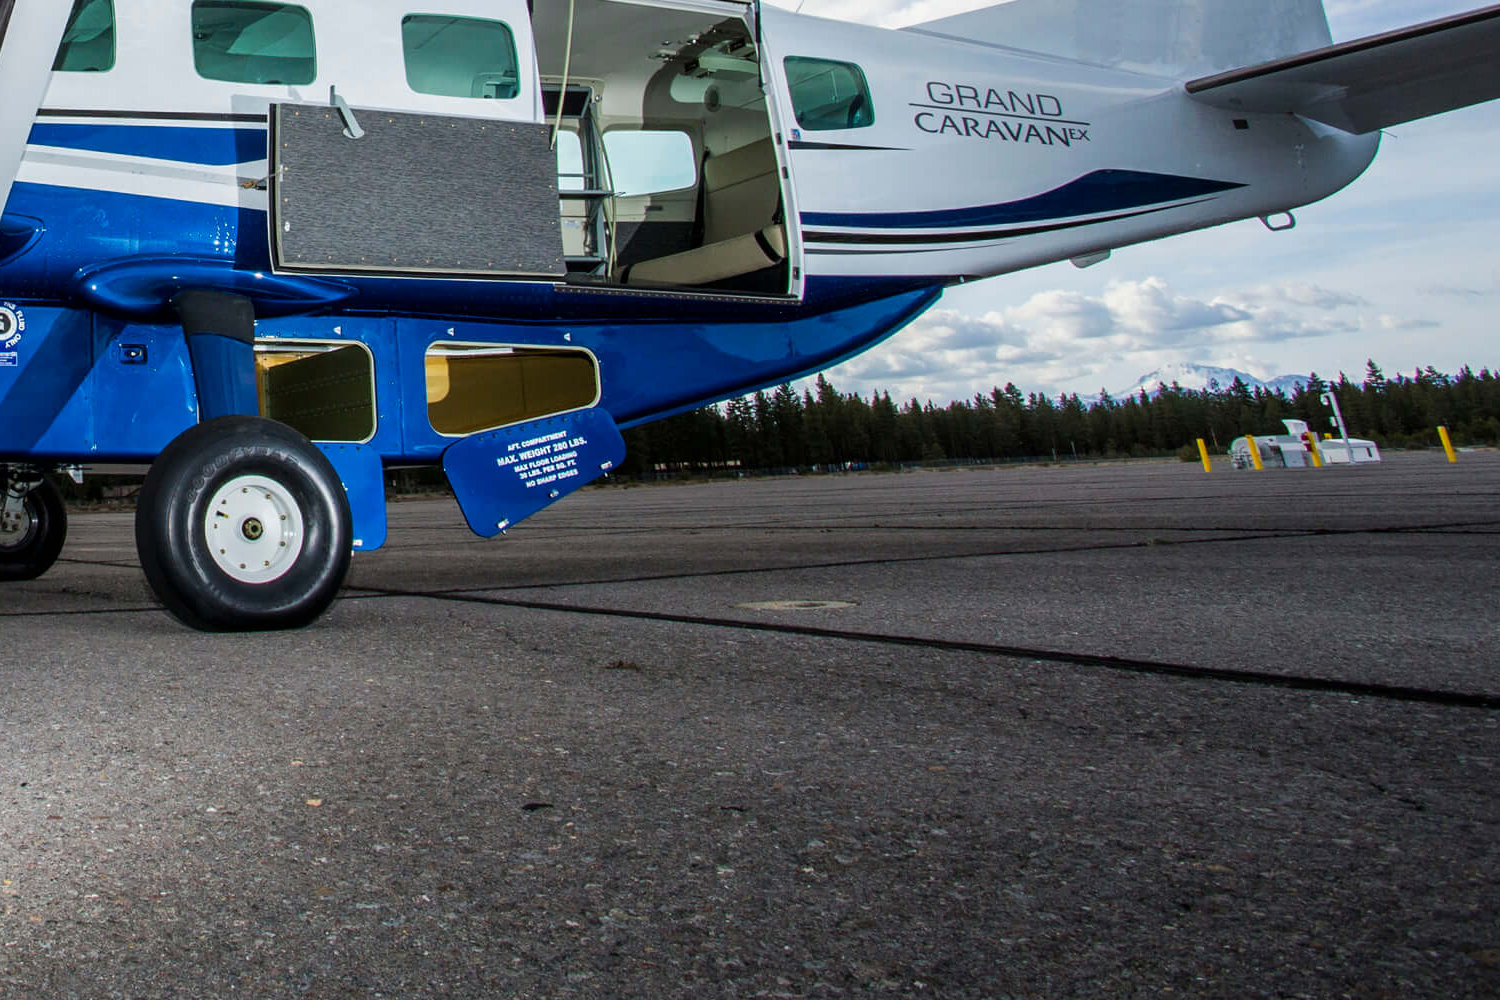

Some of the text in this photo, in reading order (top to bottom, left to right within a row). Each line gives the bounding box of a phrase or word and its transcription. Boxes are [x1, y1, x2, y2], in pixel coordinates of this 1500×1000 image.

[926, 81, 1062, 117] GRAND
[16, 311, 25, 331] FLUID
[5, 333, 21, 348] ONLY
[521, 431, 567, 447] COMPARTMENT
[497, 454, 518, 466] MAX.
[518, 445, 552, 461] WEIGHT
[569, 437, 587, 447] LBS.
[513, 450, 578, 473] MAX FLOOR LOADING
[525, 468, 579, 488] NO SHARP EDGES
[542, 465, 556, 473] PER
